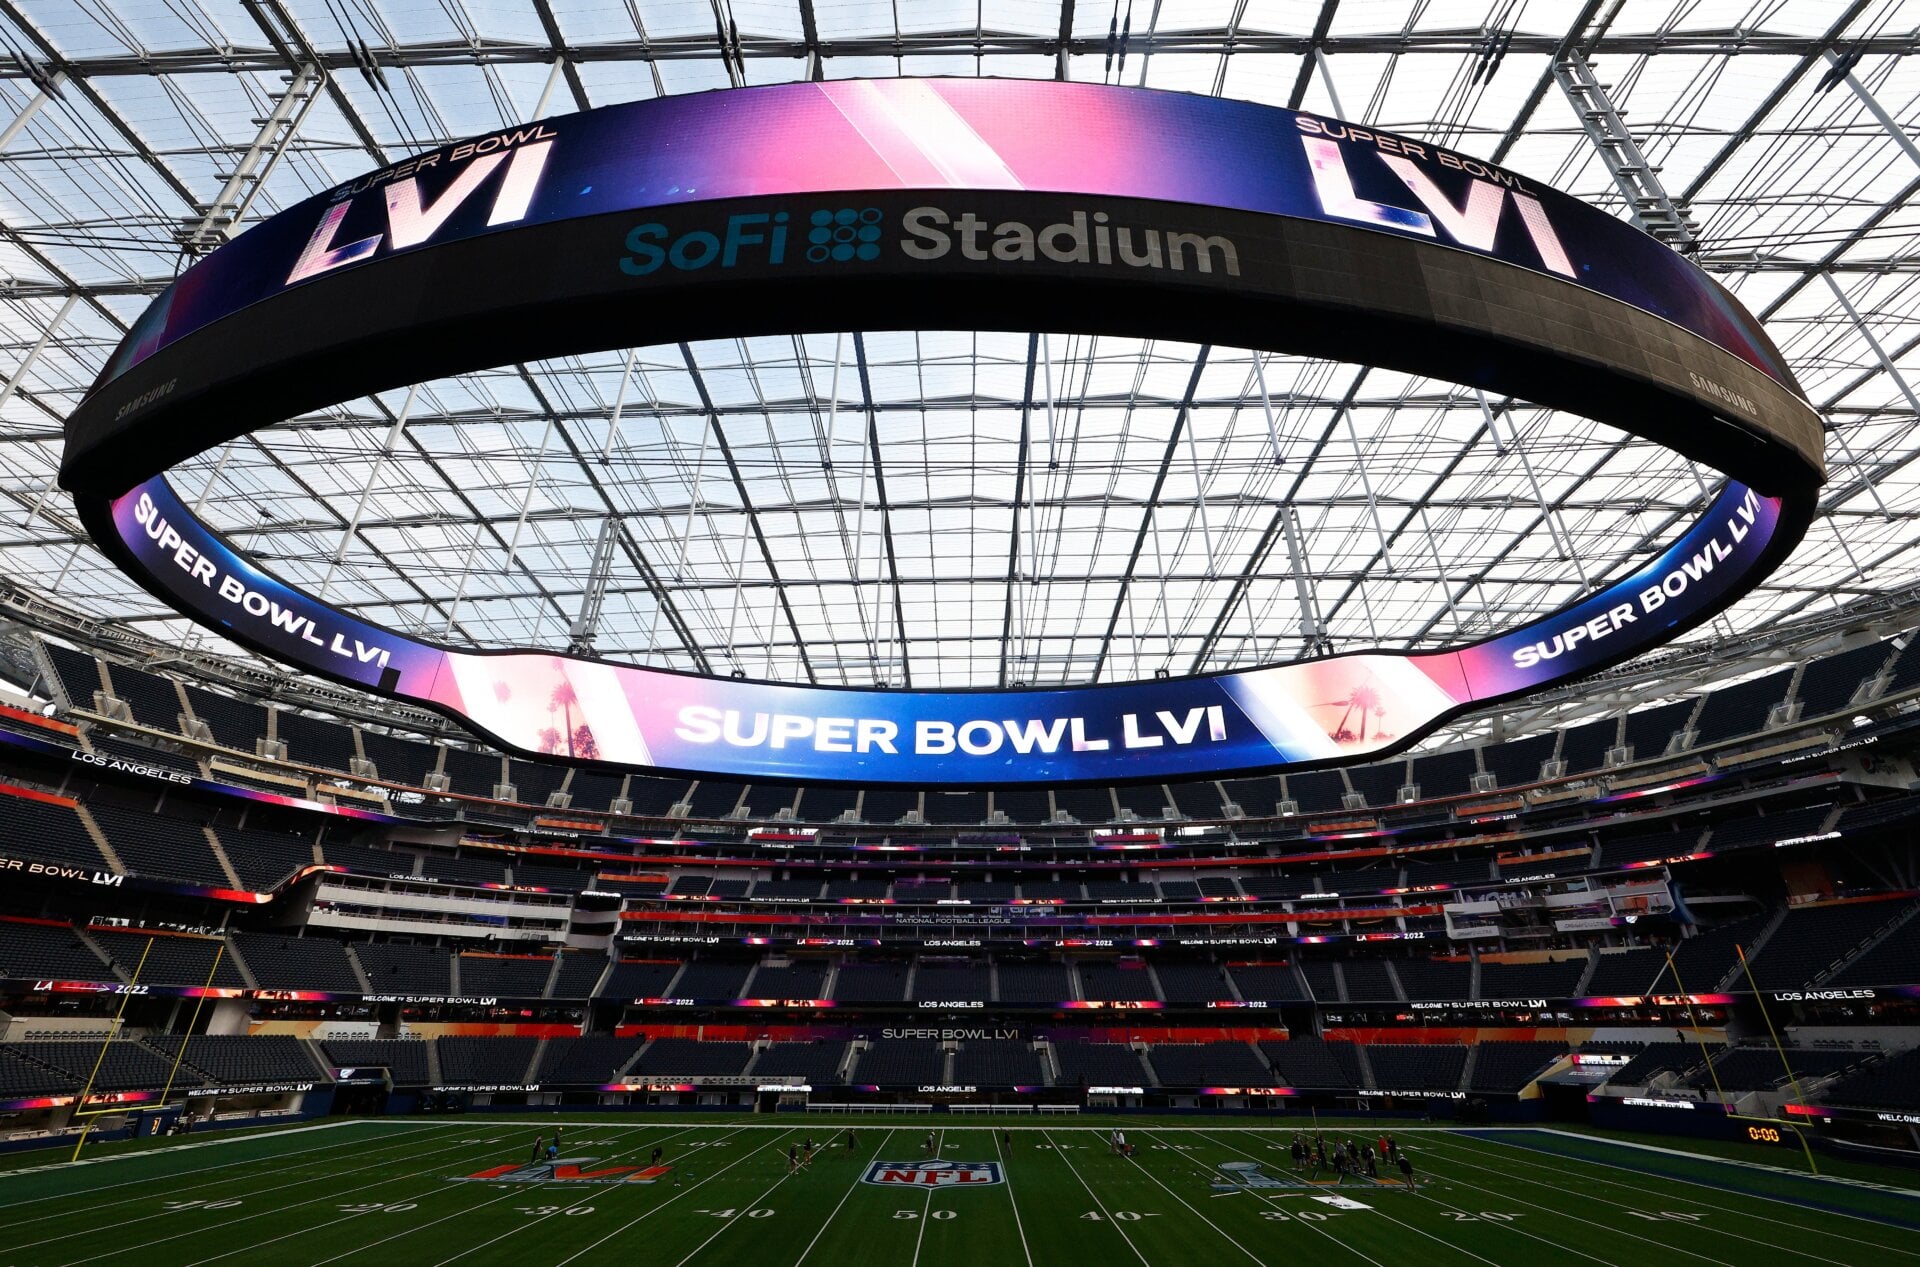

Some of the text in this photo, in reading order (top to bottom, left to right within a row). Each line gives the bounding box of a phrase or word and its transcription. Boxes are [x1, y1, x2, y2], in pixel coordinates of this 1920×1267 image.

[1295, 116, 1537, 197] SUPER BOWL
[330, 126, 557, 202] SUPER BOWL
[285, 140, 553, 286] LVI
[1301, 135, 1577, 279] LVI
[618, 206, 1241, 277] SoFi Stadium
[115, 378, 178, 421] SAMSUNG
[1689, 372, 1758, 416] SAMSUNG
[134, 492, 390, 669] SUPER BOWL LVI
[1512, 602, 1638, 669] SUPER
[1639, 538, 1734, 614] BOWL
[673, 704, 1227, 755] SUPER BOWL LVI
[1840, 741, 1864, 750] BOWL
[1864, 736, 1878, 744] LVI
[71, 750, 193, 785] LOS ANGELES
[28, 863, 89, 881] BOWL
[91, 871, 124, 887] LVI
[404, 874, 439, 883] ANGELES
[1521, 873, 1556, 882] ANGELES
[706, 936, 720, 944] LVI
[1263, 937, 1277, 945] LVI
[1403, 932, 1425, 940] 2022
[33, 980, 54, 991] LA
[405, 996, 445, 1004] SUPER
[446, 997, 479, 1005] BOWL
[480, 997, 497, 1006] LVI
[1774, 989, 1876, 1001] LOS ANGELES
[675, 998, 695, 1006] 2022
[1451, 1001, 1490, 1009] SUPER
[1492, 1000, 1528, 1008] BOWL
[1527, 999, 1547, 1008] LVI
[881, 1028, 1019, 1040] SUPER BOWL LVI
[227, 1086, 264, 1095] SUPER
[265, 1085, 296, 1093] BOWL
[296, 1083, 313, 1091] LVI
[525, 1084, 540, 1092] LVI
[1450, 1091, 1466, 1099] LVI
[1877, 1113, 1920, 1124] WELCOME
[1748, 1126, 1780, 1143] 0:00
[878, 1169, 988, 1185] NFL
[525, 1205, 595, 1217] 30
[708, 1208, 776, 1219] 40
[892, 1209, 958, 1220] 50
[1079, 1210, 1142, 1221] 40
[1259, 1210, 1328, 1221] 30
